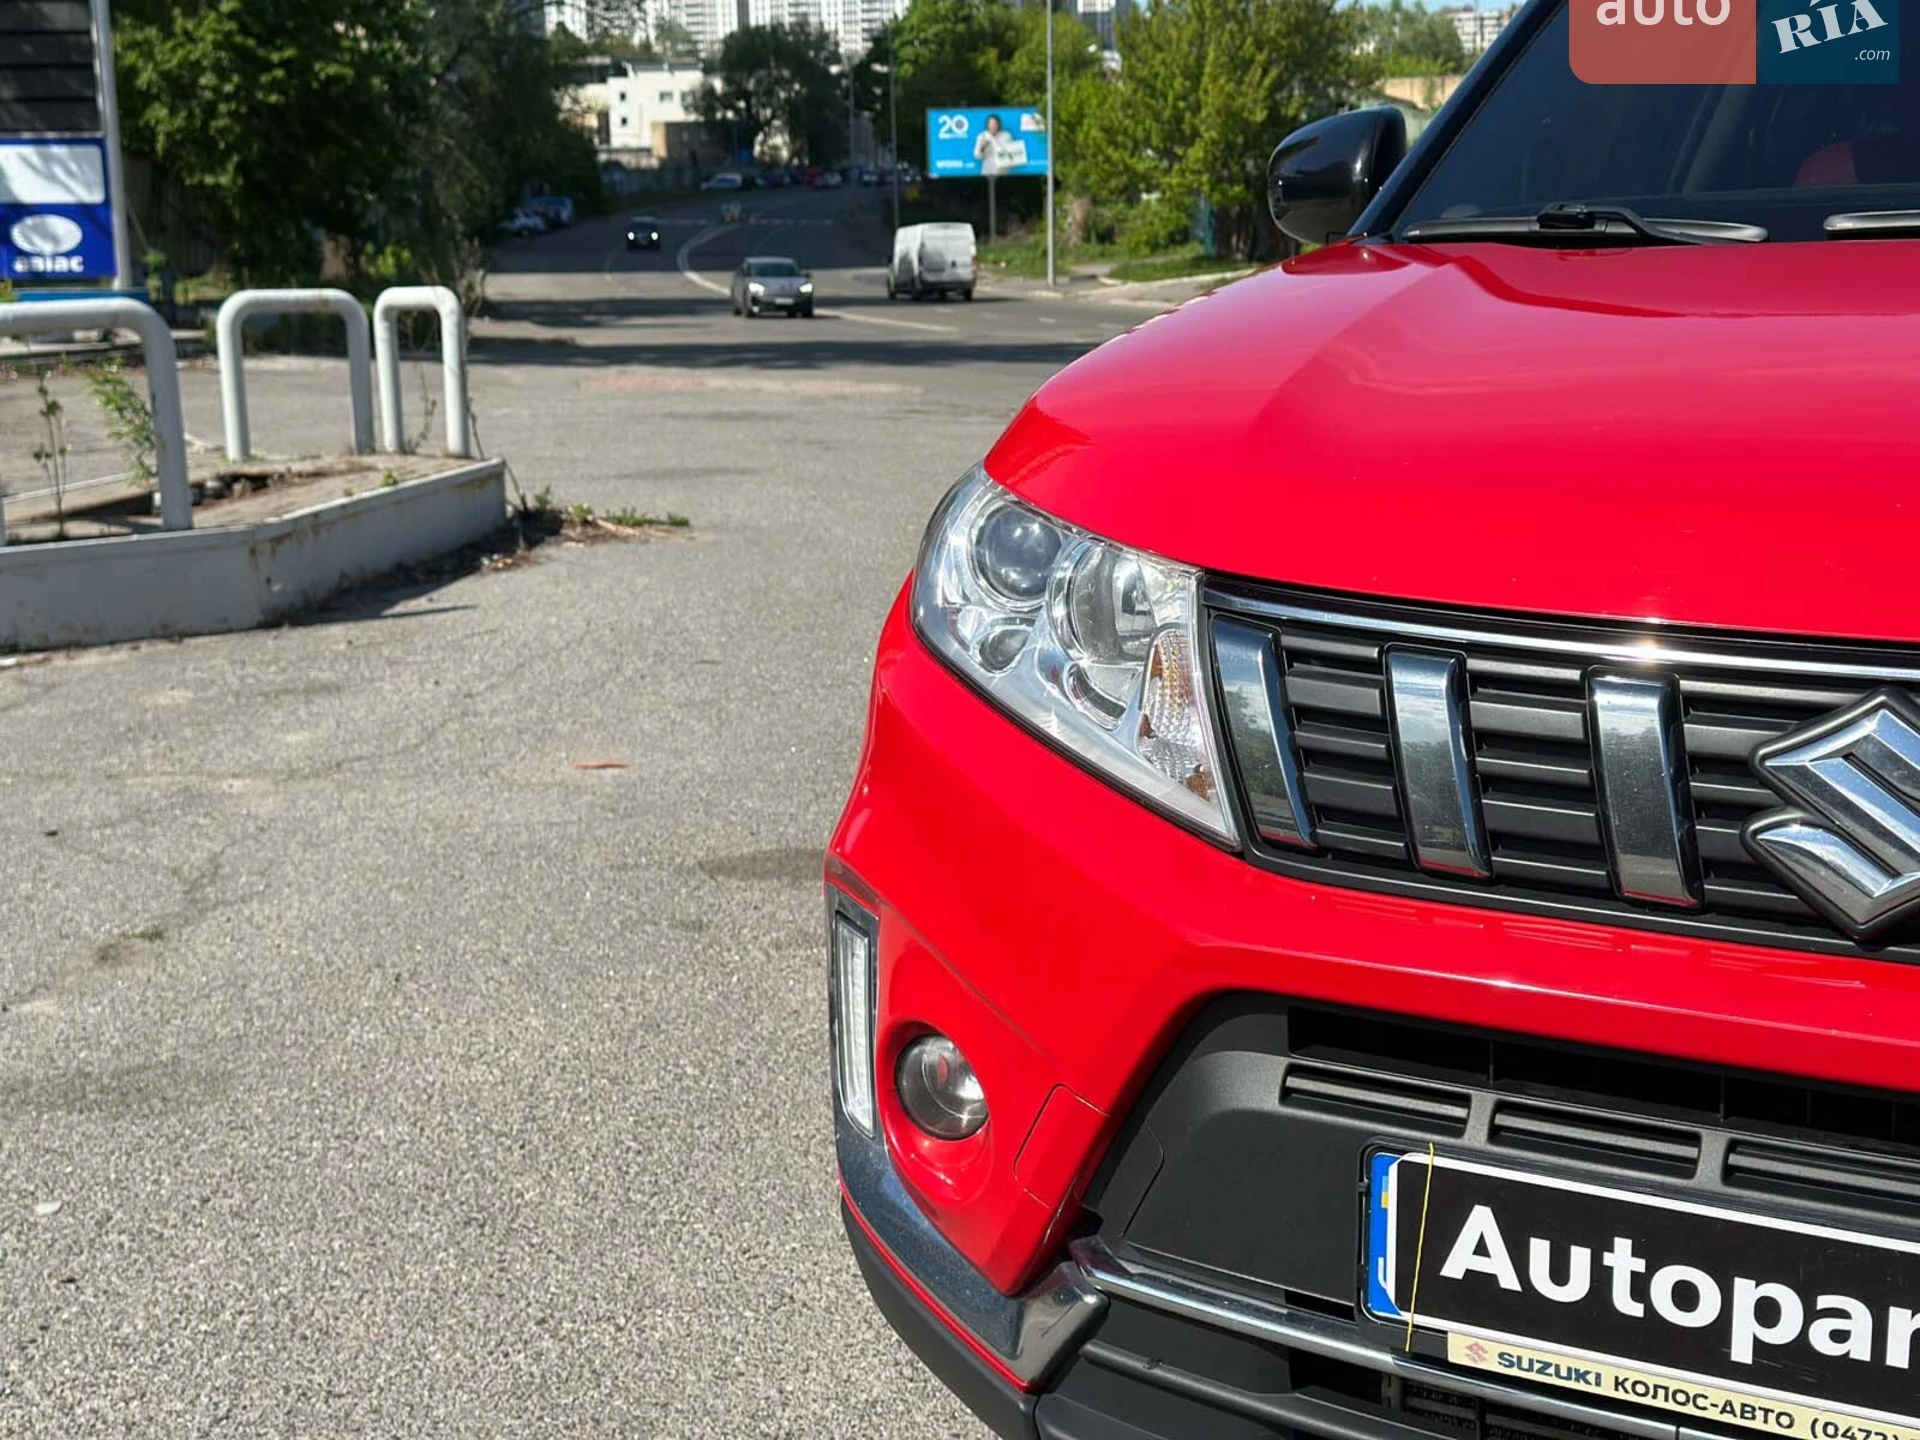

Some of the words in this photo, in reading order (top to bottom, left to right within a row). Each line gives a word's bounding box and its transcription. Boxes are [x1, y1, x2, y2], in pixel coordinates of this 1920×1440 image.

[938, 114, 969, 134] 20
[1439, 1204, 1920, 1369] Autopar
[1497, 1351, 1602, 1388] SUZUKI
[1613, 1375, 1796, 1430] КОЛОС-АВТО
